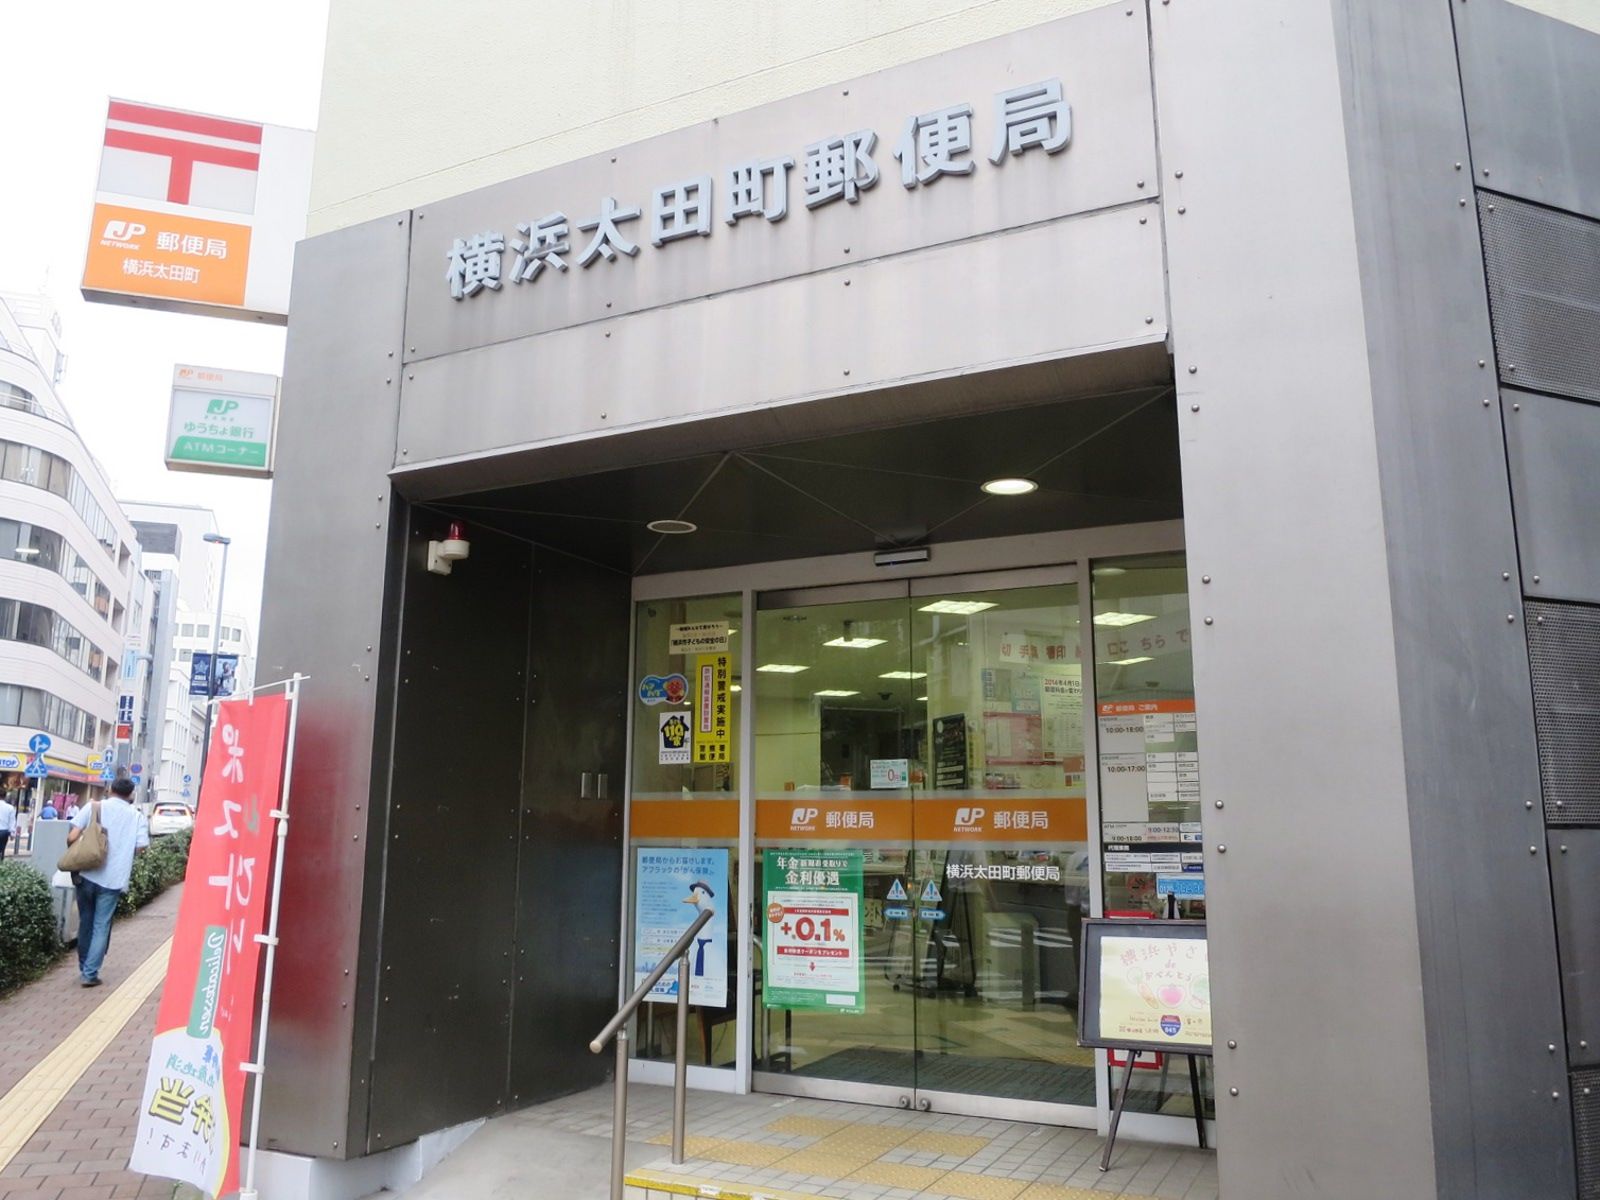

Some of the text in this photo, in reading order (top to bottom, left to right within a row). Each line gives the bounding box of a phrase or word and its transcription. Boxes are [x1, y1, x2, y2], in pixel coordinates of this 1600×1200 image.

[445, 77, 1073, 300] 横浜太田町郵便局
[100, 239, 140, 251] NETWORK
[156, 231, 228, 260] 郵便局
[122, 257, 201, 284] 横浜太田町
[184, 421, 255, 440] ゆうちょ銀行
[183, 441, 260, 457] ATMコーナー
[716, 656, 727, 739] 特別警戒実施中
[825, 810, 875, 829] 郵便局
[993, 811, 1049, 830] 郵便局
[785, 870, 840, 887] 金利優遇
[945, 863, 1061, 882] 横浜太田町郵便局
[1120, 943, 1199, 966] 横浜やさ
